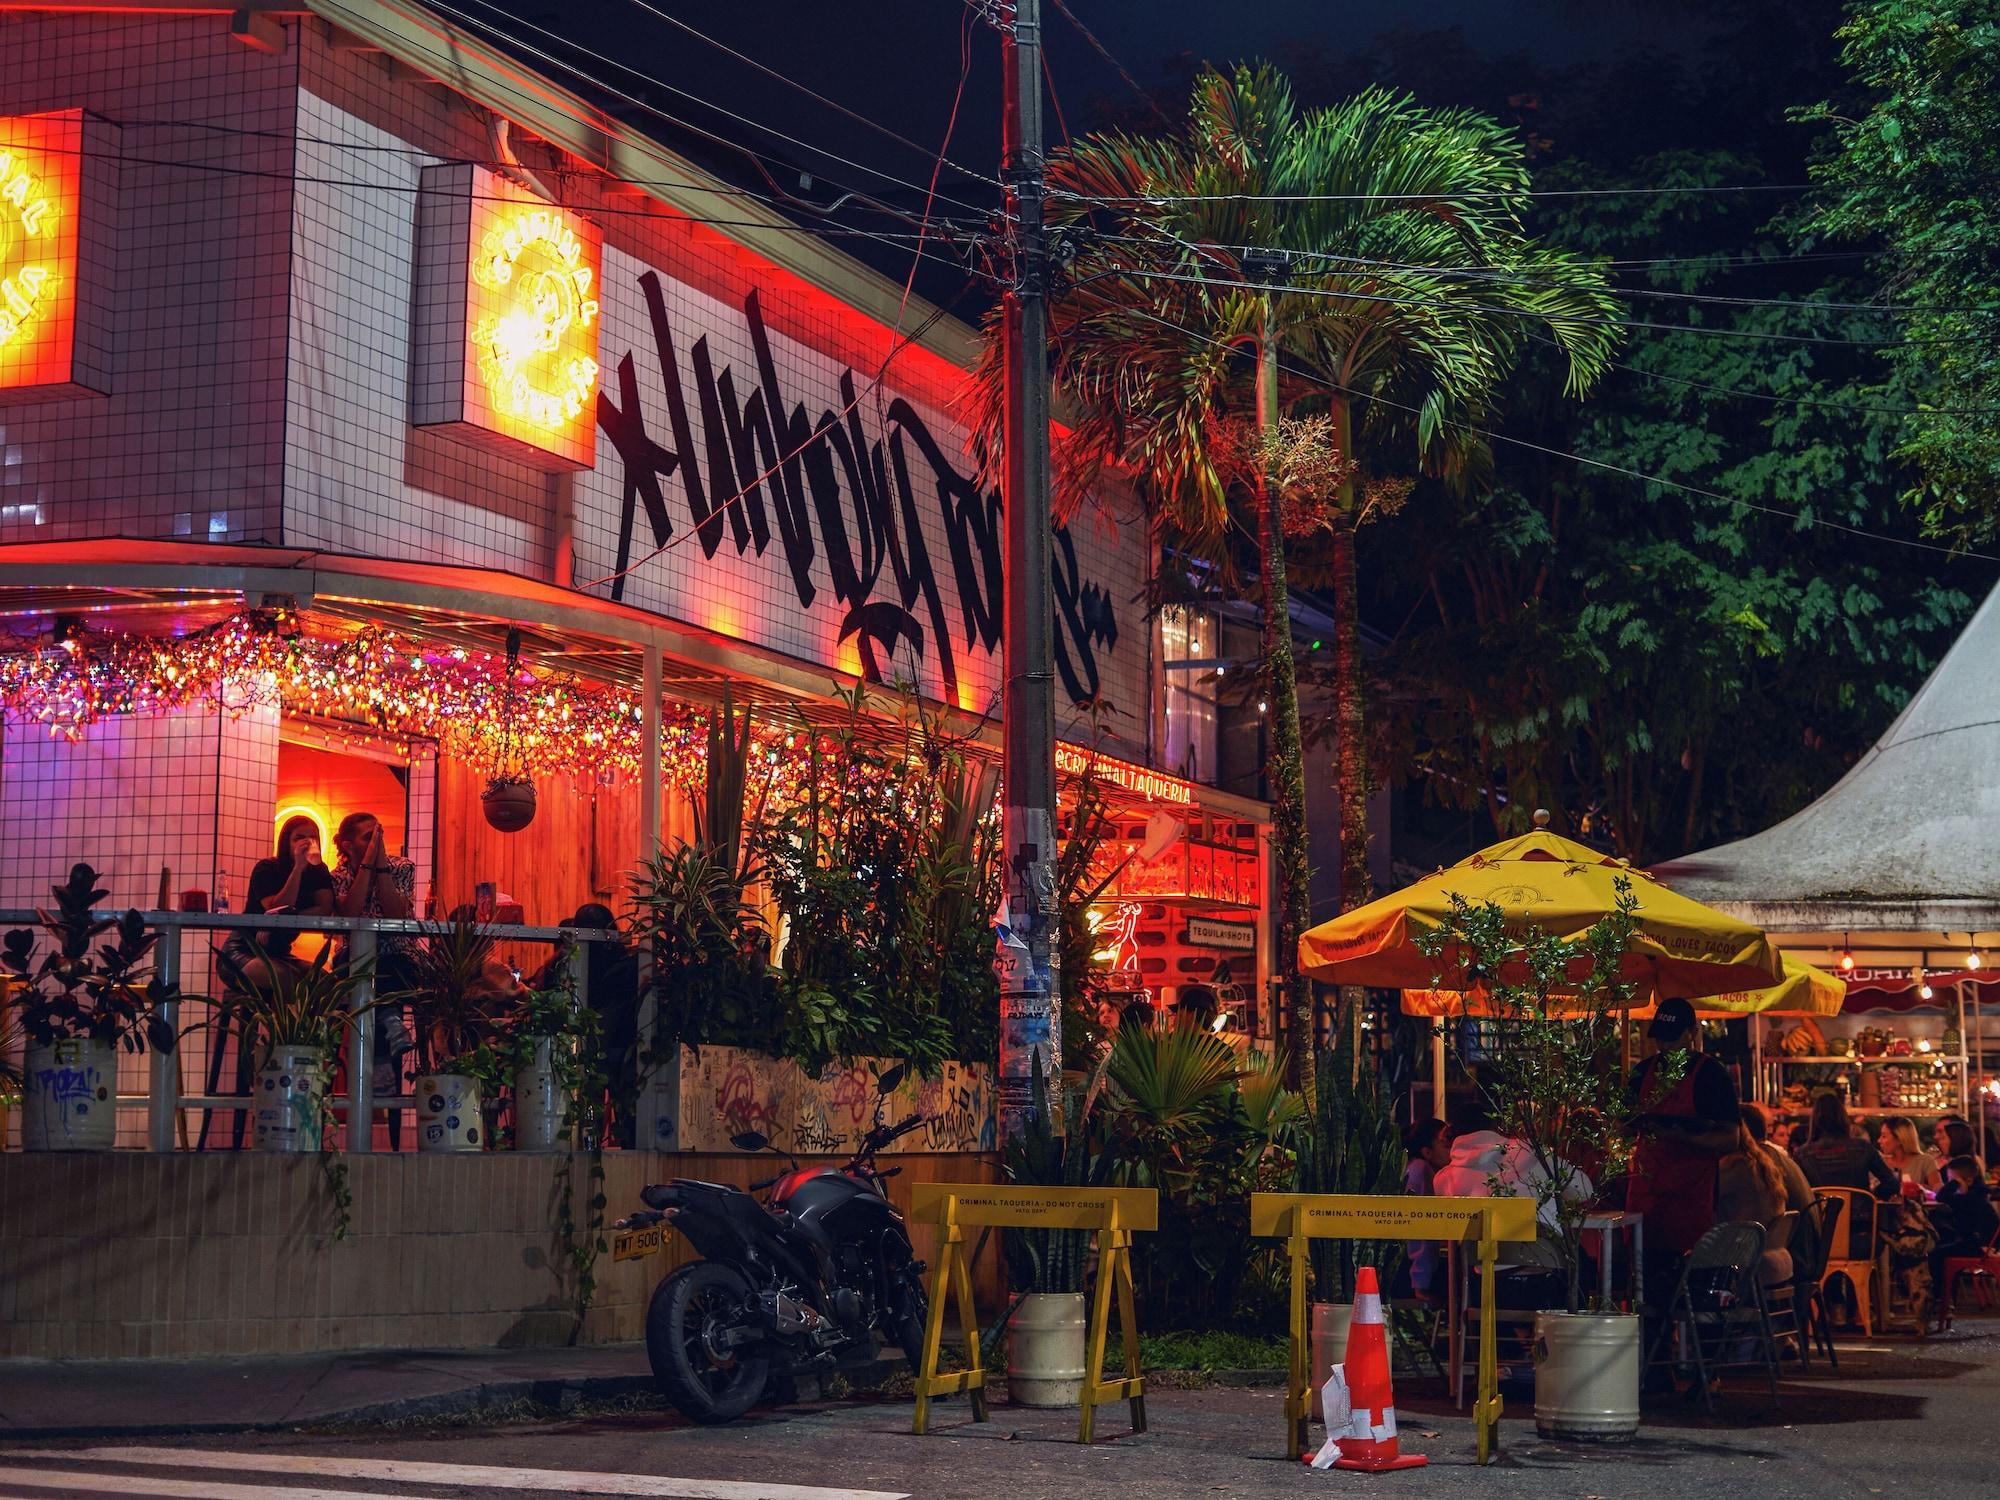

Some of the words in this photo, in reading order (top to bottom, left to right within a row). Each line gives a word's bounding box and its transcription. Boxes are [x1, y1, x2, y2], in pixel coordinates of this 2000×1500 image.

[1193, 926, 1224, 938] TEQUILA
[1227, 931, 1251, 942] SHOTS
[1670, 936, 1700, 950] LOVES
[1705, 940, 1737, 954] TACOS
[959, 1198, 997, 1206] CRIMINAL
[1046, 1200, 1057, 1208] DO
[1077, 1201, 1105, 1209] CROSS
[1309, 1209, 1353, 1217] CRIMINAL
[1426, 1211, 1444, 1219] NOT
[1446, 1212, 1478, 1220] CROSS
